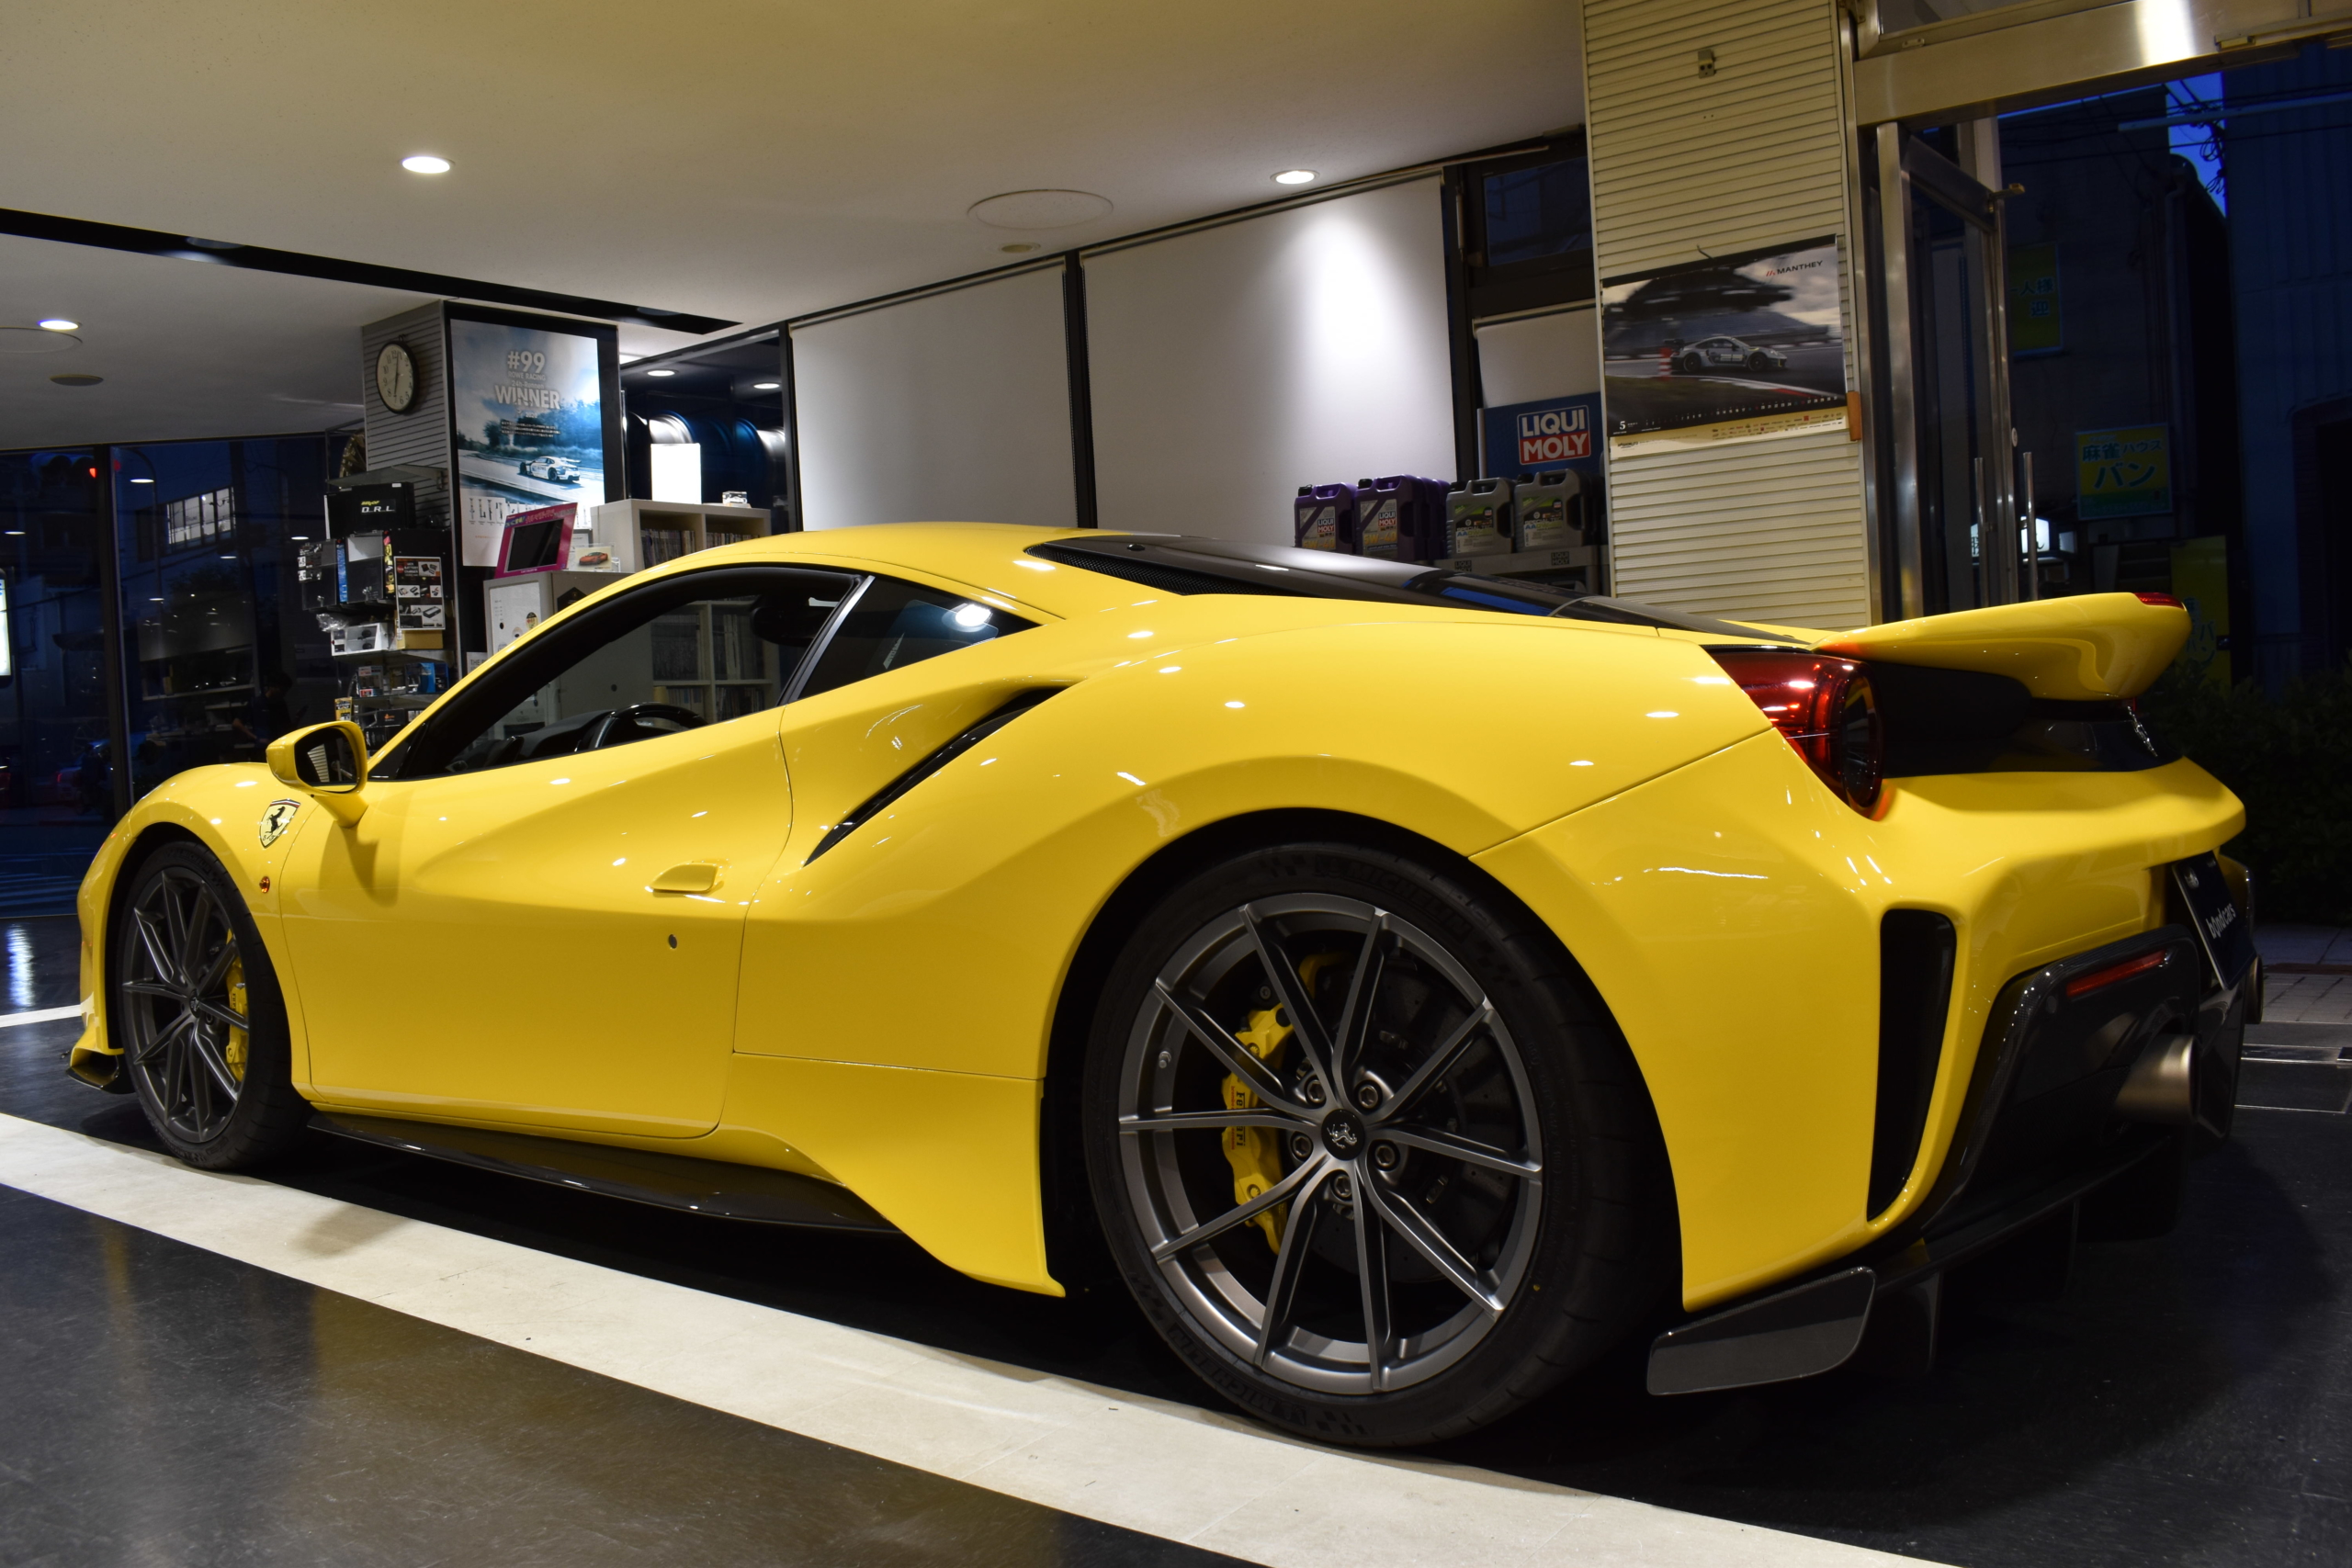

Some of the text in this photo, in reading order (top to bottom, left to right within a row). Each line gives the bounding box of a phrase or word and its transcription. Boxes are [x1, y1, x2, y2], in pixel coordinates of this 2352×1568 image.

[1777, 260, 1823, 275] MANTHEY
[507, 351, 545, 374] #99
[508, 371, 546, 381] ROWE RACING
[494, 385, 560, 410] WINNER
[1521, 409, 1586, 437] LIQUI
[1619, 421, 1626, 430] 5
[1523, 433, 1589, 462] MOLY
[2094, 462, 2155, 489] バン
[1317, 518, 1335, 526] LIQUI
[1379, 511, 1396, 520] LIQUI
[1379, 517, 1396, 526] MOLY
[1317, 525, 1335, 533] MOLY
[1363, 531, 1397, 546] 5W-40
[1455, 560, 1472, 569] LIQUI
[1552, 558, 1569, 566] MOLY
[1236, 1091, 1246, 1146] Feari
[1169, 1328, 1276, 1414] MICHELIN
